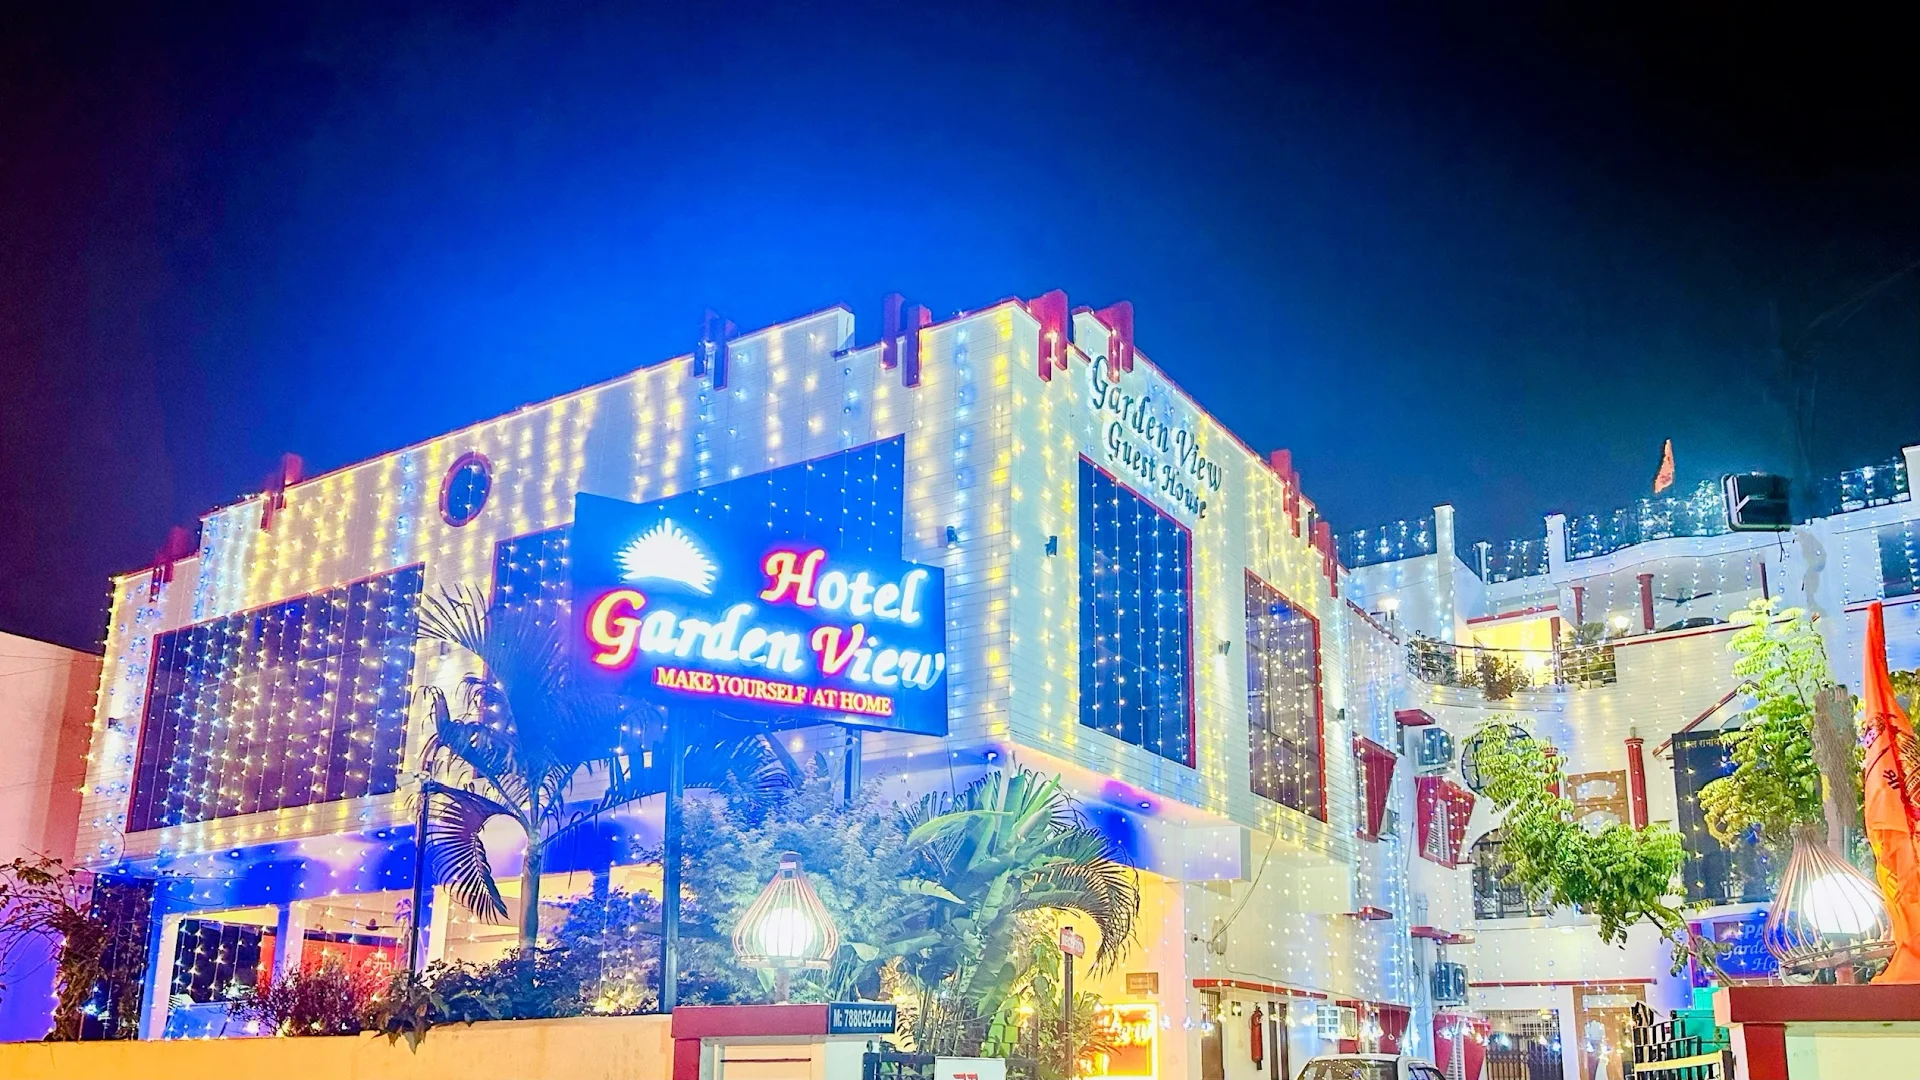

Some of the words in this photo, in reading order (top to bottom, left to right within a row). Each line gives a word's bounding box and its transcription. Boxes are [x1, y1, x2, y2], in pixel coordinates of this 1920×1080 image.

[1092, 355, 1169, 453] Garden
[1176, 430, 1222, 492] View
[1108, 421, 1156, 482] Guest
[1161, 464, 1207, 519] House
[760, 548, 928, 625] Hotel
[587, 589, 804, 673] Garden
[810, 623, 945, 689] View
[656, 666, 715, 693] MAKE
[715, 673, 808, 704] YOURSELF
[811, 687, 837, 707] AT
[839, 690, 893, 715] HOME
[1720, 941, 1767, 961] Garde
[844, 1008, 893, 1028] 7880324444
